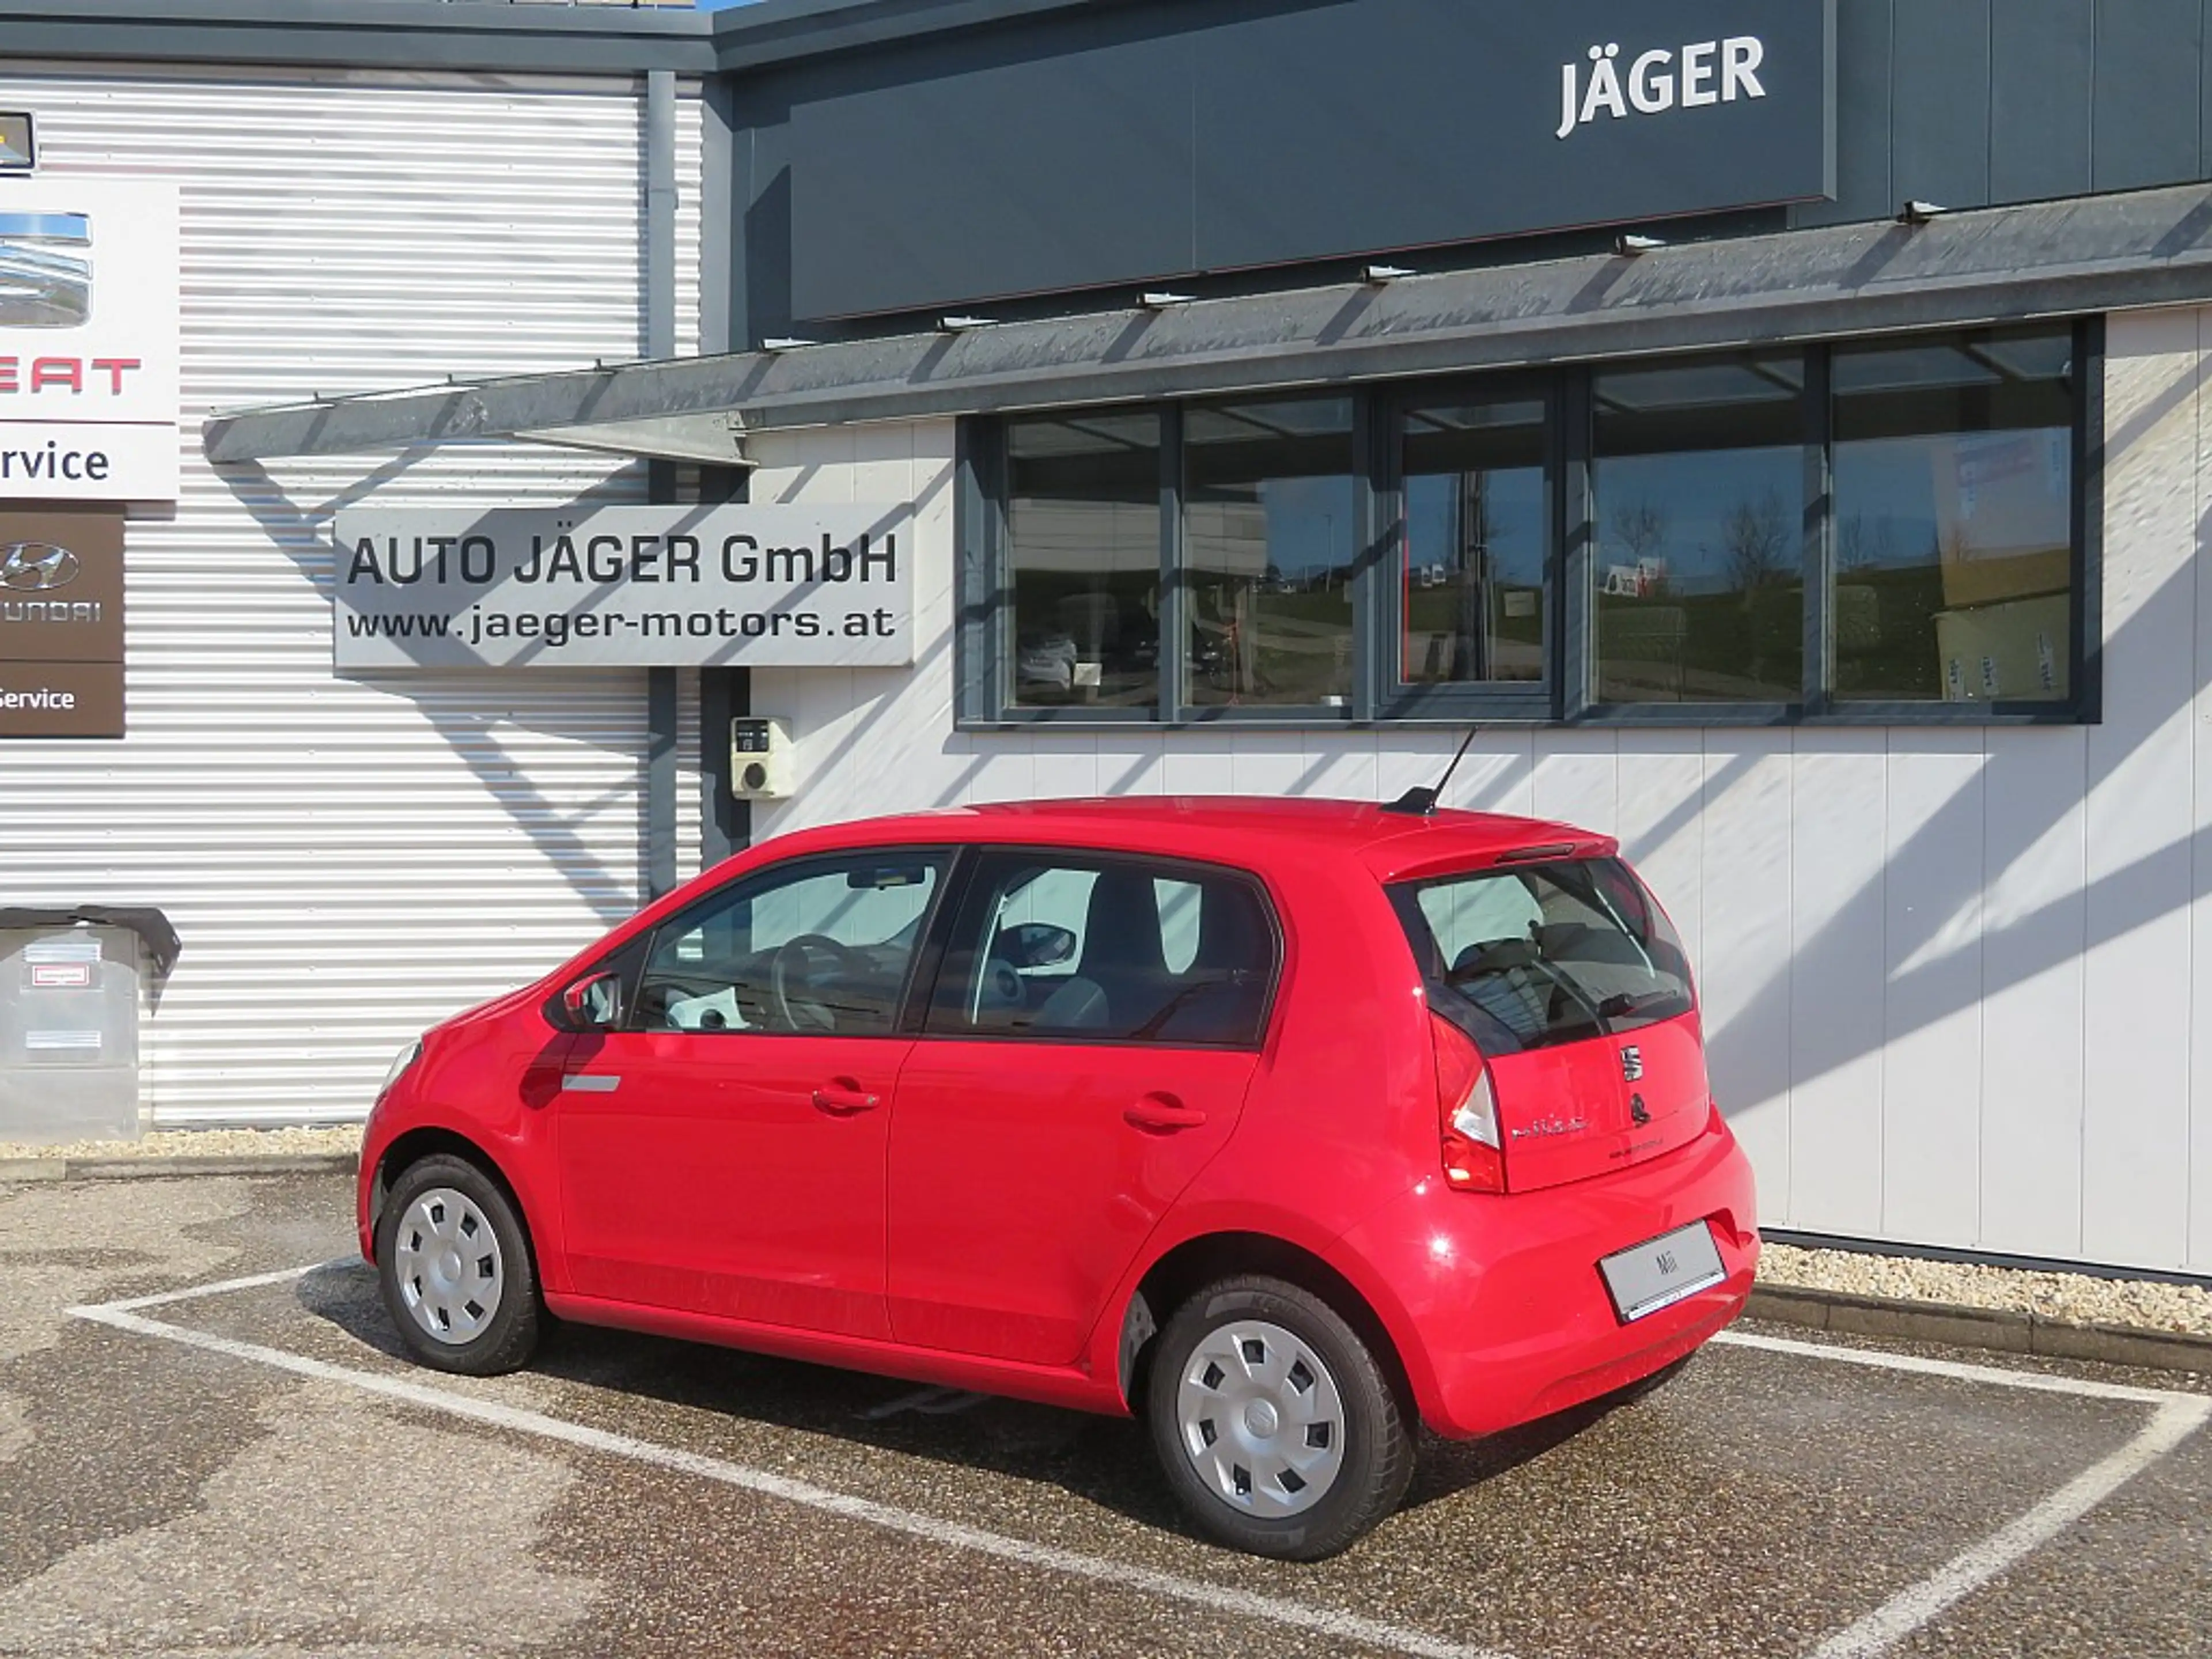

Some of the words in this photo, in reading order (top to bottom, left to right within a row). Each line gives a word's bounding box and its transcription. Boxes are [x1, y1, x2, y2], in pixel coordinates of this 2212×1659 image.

[1556, 36, 1766, 139] JÄGER
[347, 536, 495, 584] AUTO
[514, 521, 699, 582] JÄGER
[722, 533, 895, 582] GmbH
[0, 602, 100, 622] UNDAI
[347, 605, 895, 646] www.jaeger-motors.at
